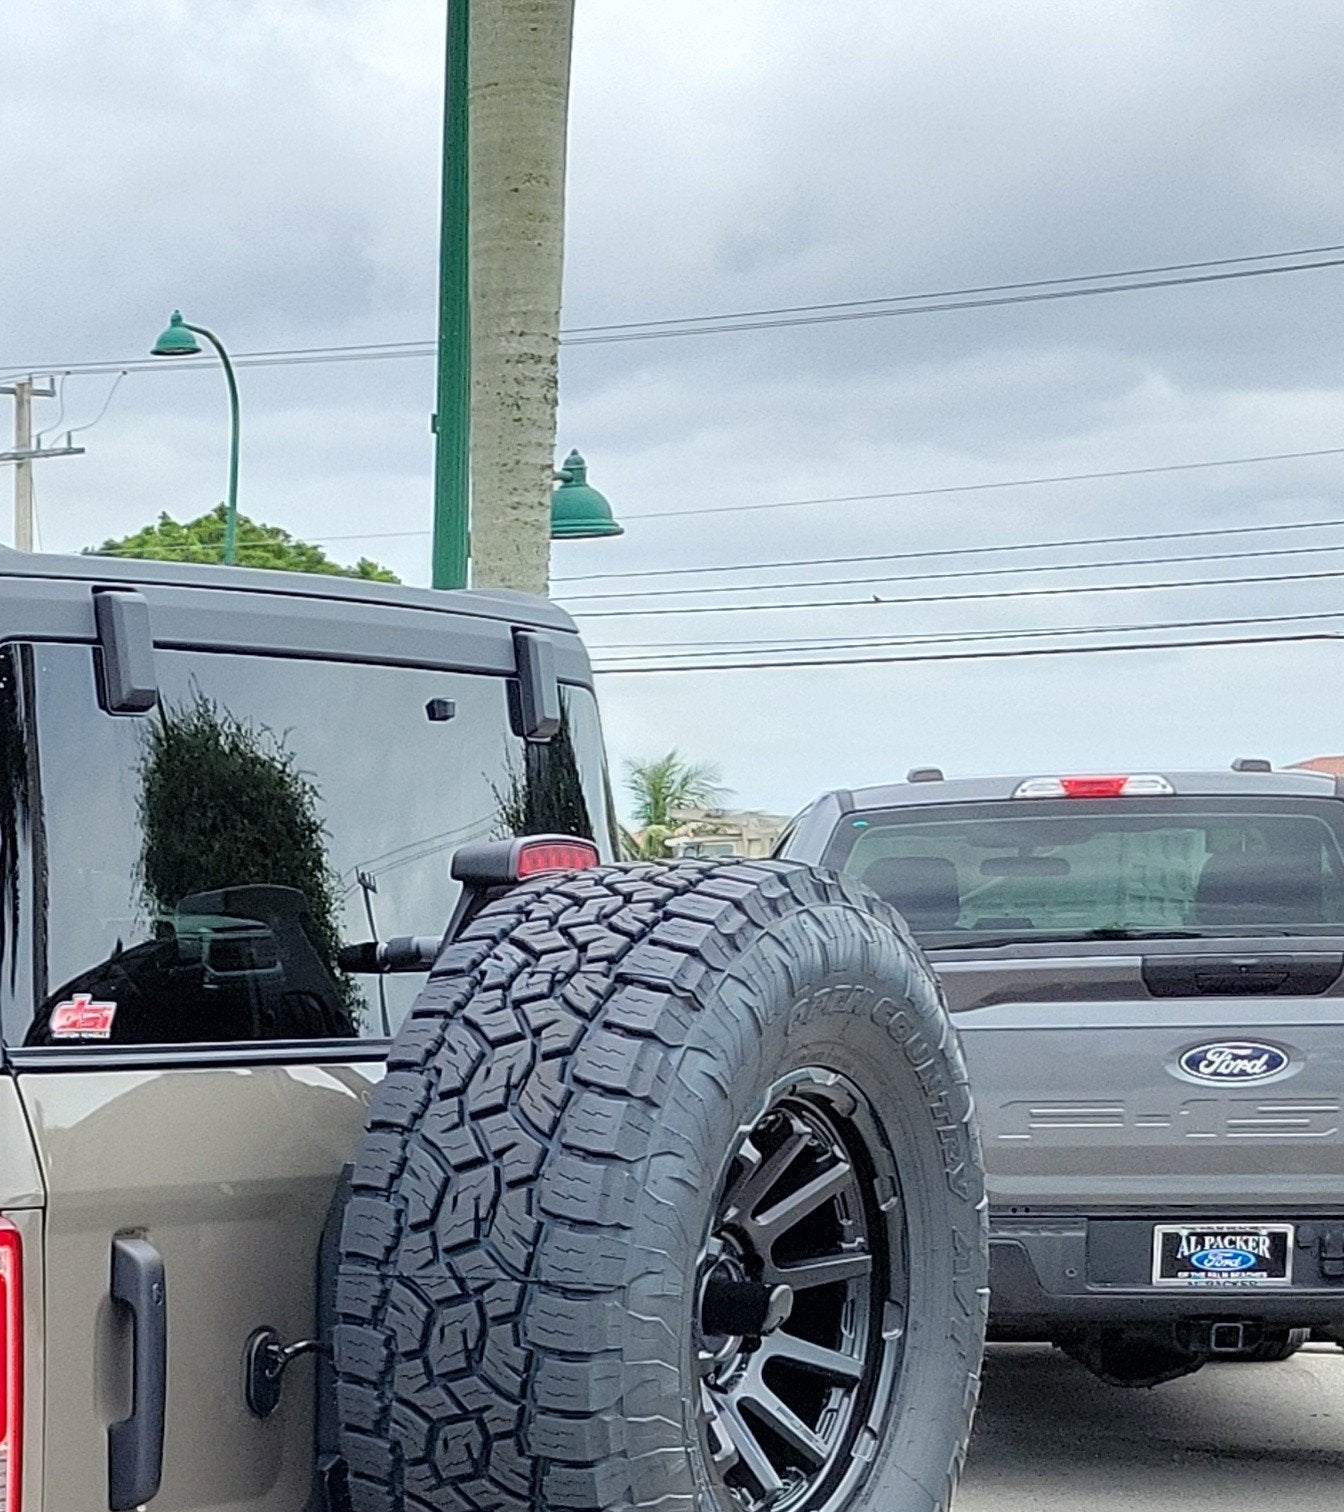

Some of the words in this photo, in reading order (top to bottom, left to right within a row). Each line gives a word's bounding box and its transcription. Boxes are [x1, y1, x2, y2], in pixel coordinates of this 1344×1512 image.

[1198, 1048, 1267, 1075] Ford
[870, 996, 972, 1201] COUNTRY
[1176, 1233, 1202, 1259] AL
[1202, 1235, 1271, 1260] PACKER
[1203, 1251, 1243, 1268] Ford
